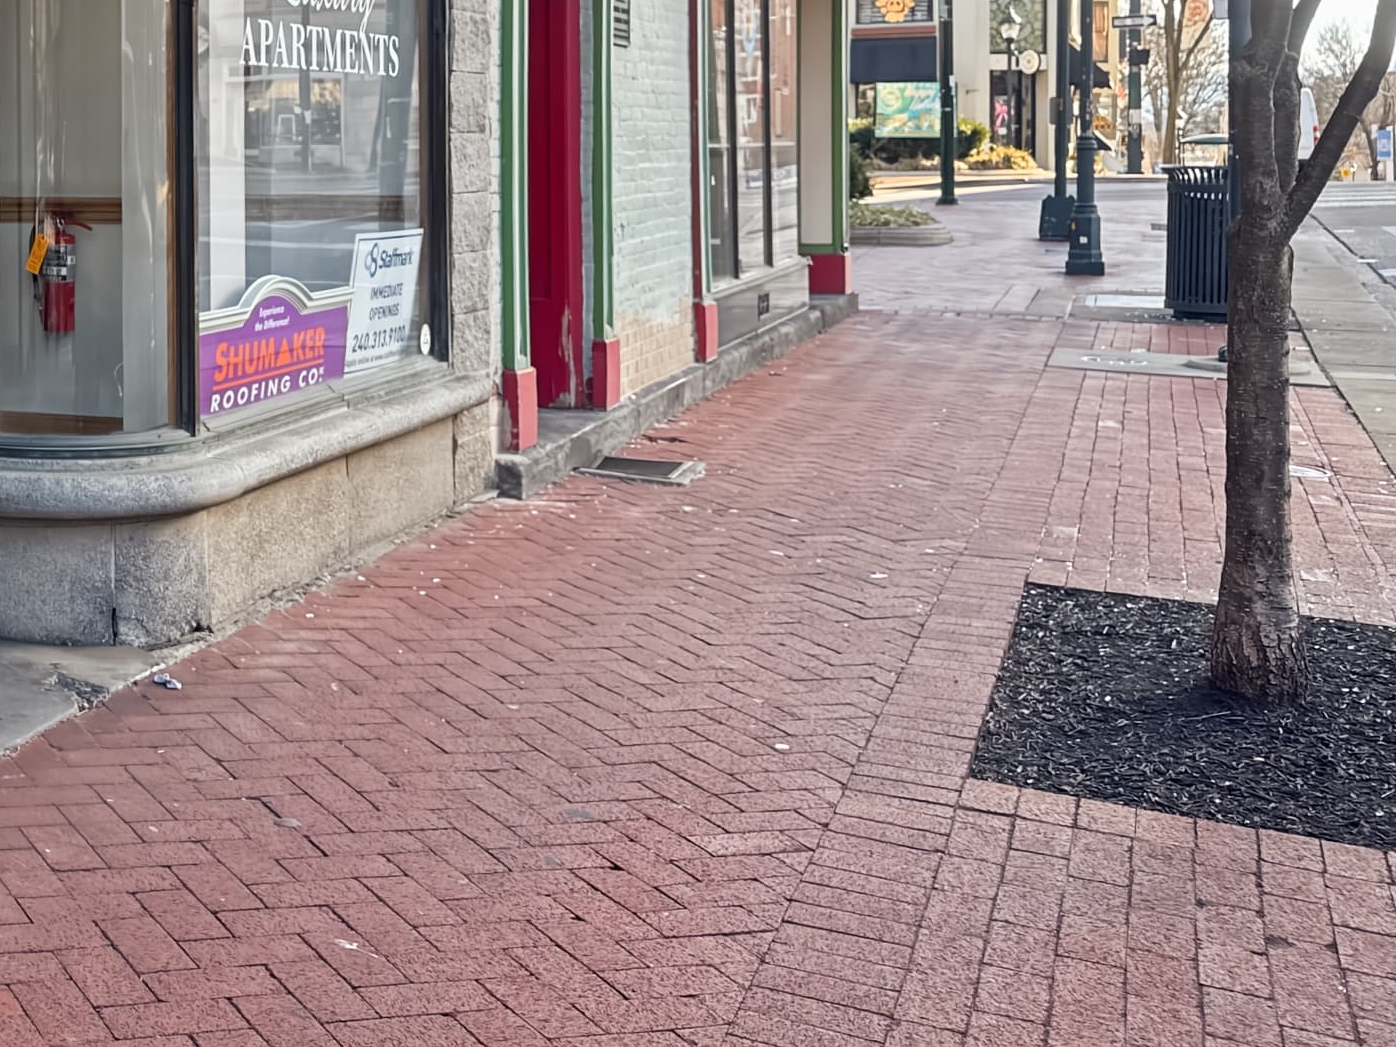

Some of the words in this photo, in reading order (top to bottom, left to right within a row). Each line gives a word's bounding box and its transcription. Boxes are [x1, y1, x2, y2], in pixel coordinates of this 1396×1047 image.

[239, 17, 400, 79] APARTMENTS
[379, 248, 413, 269] Staffmark
[213, 326, 325, 383] SHUMAKER
[210, 375, 291, 413] ROOFING
